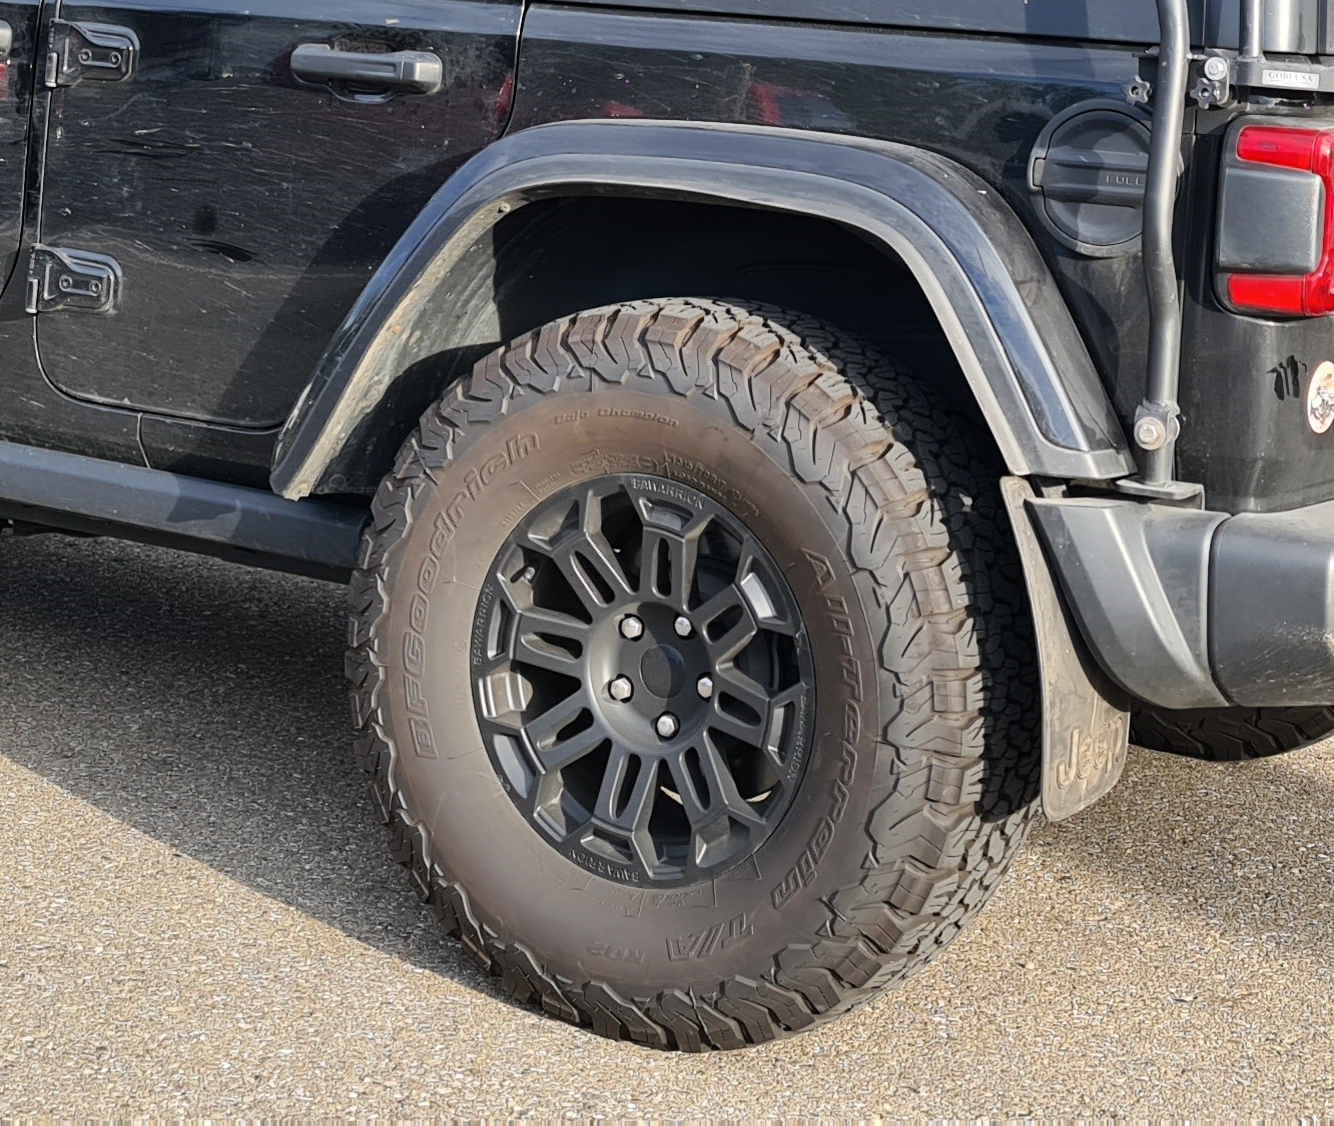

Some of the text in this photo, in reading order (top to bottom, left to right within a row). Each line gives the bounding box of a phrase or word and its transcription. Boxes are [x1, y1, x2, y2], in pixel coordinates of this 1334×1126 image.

[597, 406, 679, 427] Champion
[403, 431, 541, 761] BFGoodrich
[770, 546, 864, 911] All-Terrain
[1056, 714, 1124, 790] Jeep
[665, 912, 755, 962] T/A
